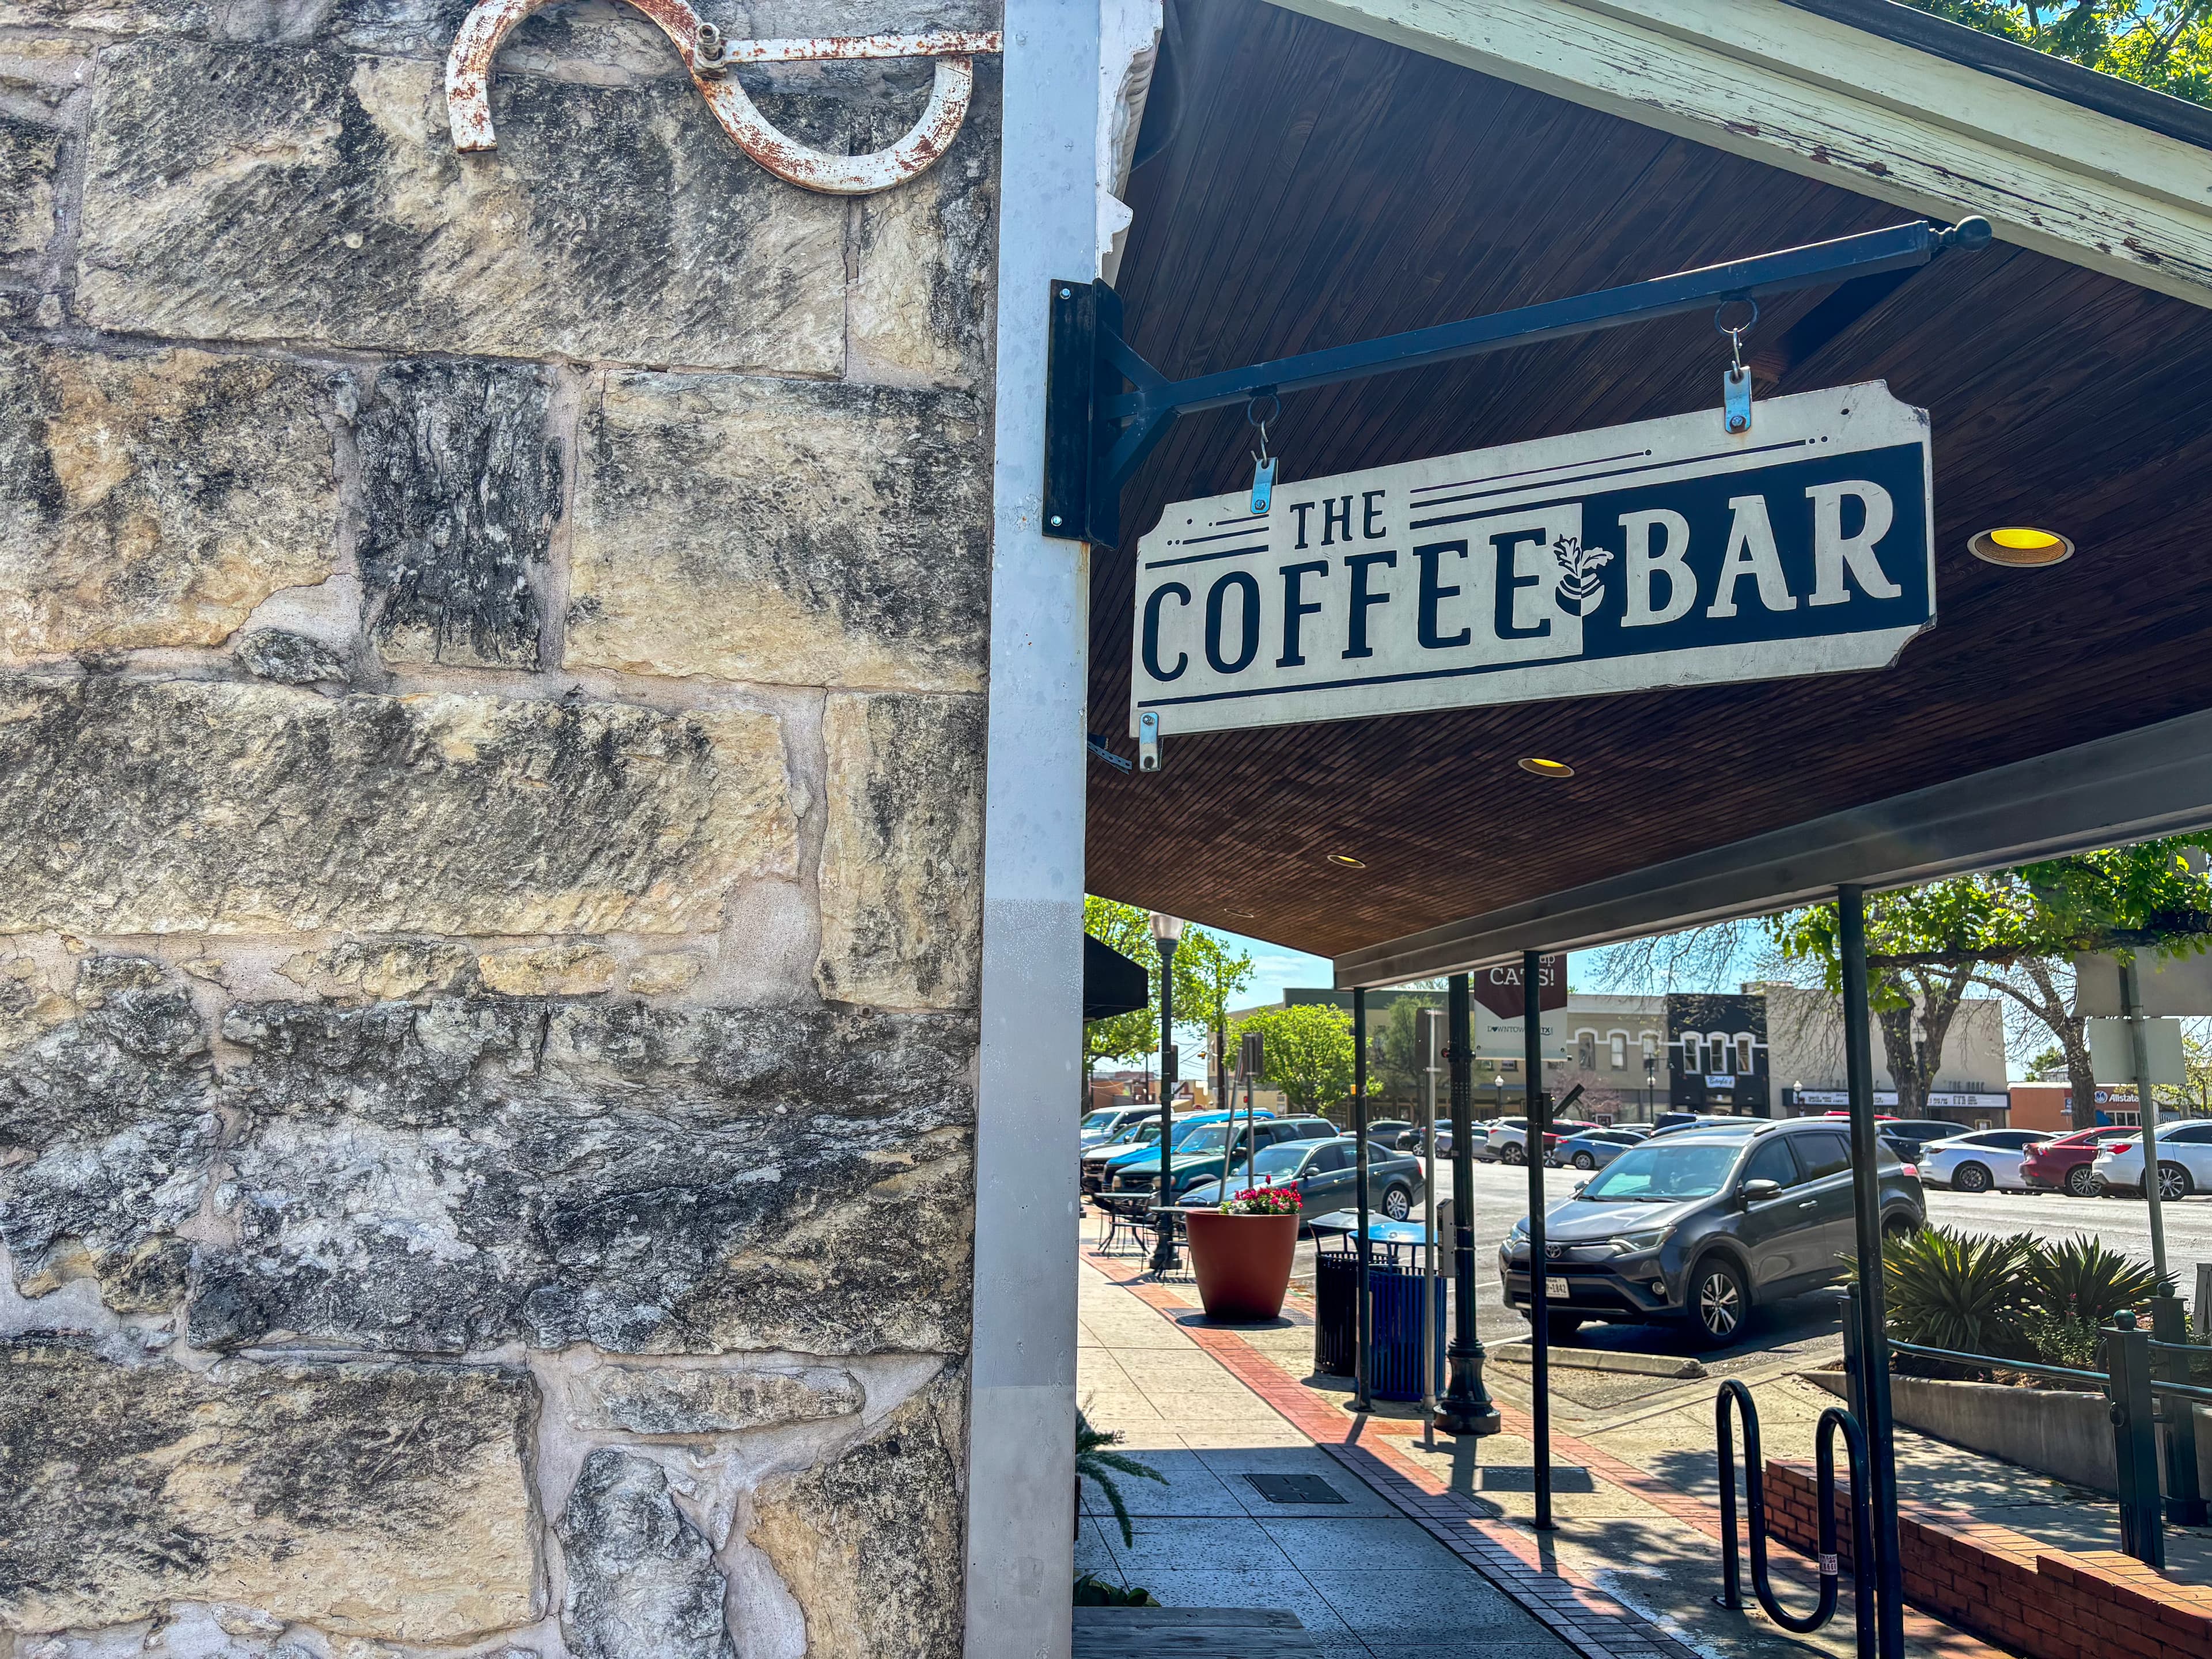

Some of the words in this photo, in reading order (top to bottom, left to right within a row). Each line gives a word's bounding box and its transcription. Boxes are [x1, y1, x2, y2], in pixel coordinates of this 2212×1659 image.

[1289, 490, 1386, 549] THE
[1142, 527, 1551, 682] COFFEE
[1619, 480, 1902, 627] BAR
[1490, 967, 1554, 987] CAS!
